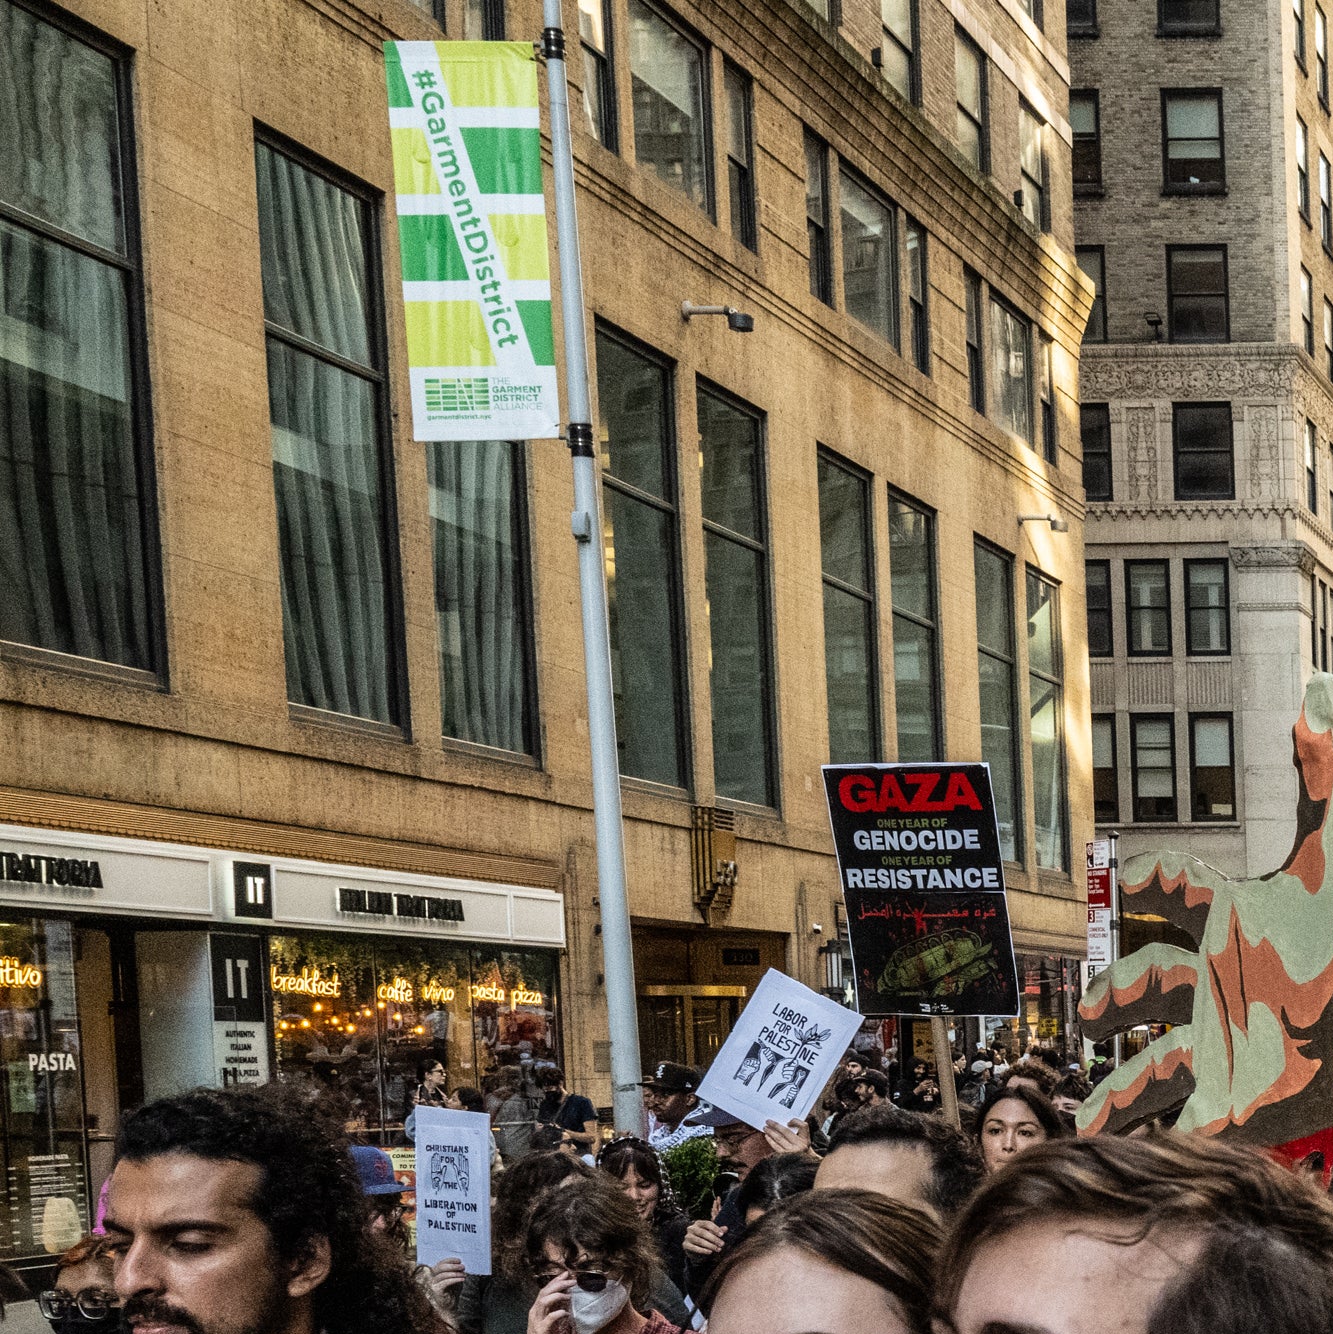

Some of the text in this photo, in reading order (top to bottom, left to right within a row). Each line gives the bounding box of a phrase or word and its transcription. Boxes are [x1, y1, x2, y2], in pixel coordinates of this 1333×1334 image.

[411, 69, 518, 349] #GarmentDistrict
[492, 377, 511, 386] THE
[492, 385, 543, 394] GARMENT
[492, 394, 539, 403] DISTRICT
[493, 402, 544, 412] ALLIANCE
[426, 414, 492, 422] garmentdistrict.nyc
[838, 772, 983, 813] GAZA
[876, 818, 948, 829] ONE YEAR OF
[853, 828, 981, 851] GENOCIDE
[881, 855, 953, 866] ONE YEAR OF
[846, 867, 1000, 890] RESISTANCE
[246, 876, 265, 905] IT
[1089, 911, 1094, 922] 3
[1089, 966, 1094, 978] 5
[225, 958, 249, 999] IT
[270, 963, 342, 997] breakfast
[377, 976, 455, 1003] caffè vino
[468, 981, 543, 1011] pasta pizza
[772, 1002, 808, 1029] LABOR
[773, 1019, 792, 1035] FOR
[225, 1030, 256, 1038] AUTHENTIC
[231, 1043, 252, 1051] ITALIAN
[758, 1027, 820, 1066] PALESTINE
[28, 1053, 77, 1072] PASTA
[225, 1056, 258, 1064] HOMEMADE
[425, 1144, 469, 1154] CHRISTIANS
[440, 1155, 455, 1164] FOR
[444, 1181, 458, 1190] THE
[424, 1199, 477, 1213] LIBERATION
[446, 1211, 456, 1219] OF
[428, 1220, 477, 1234] PALESTINE
